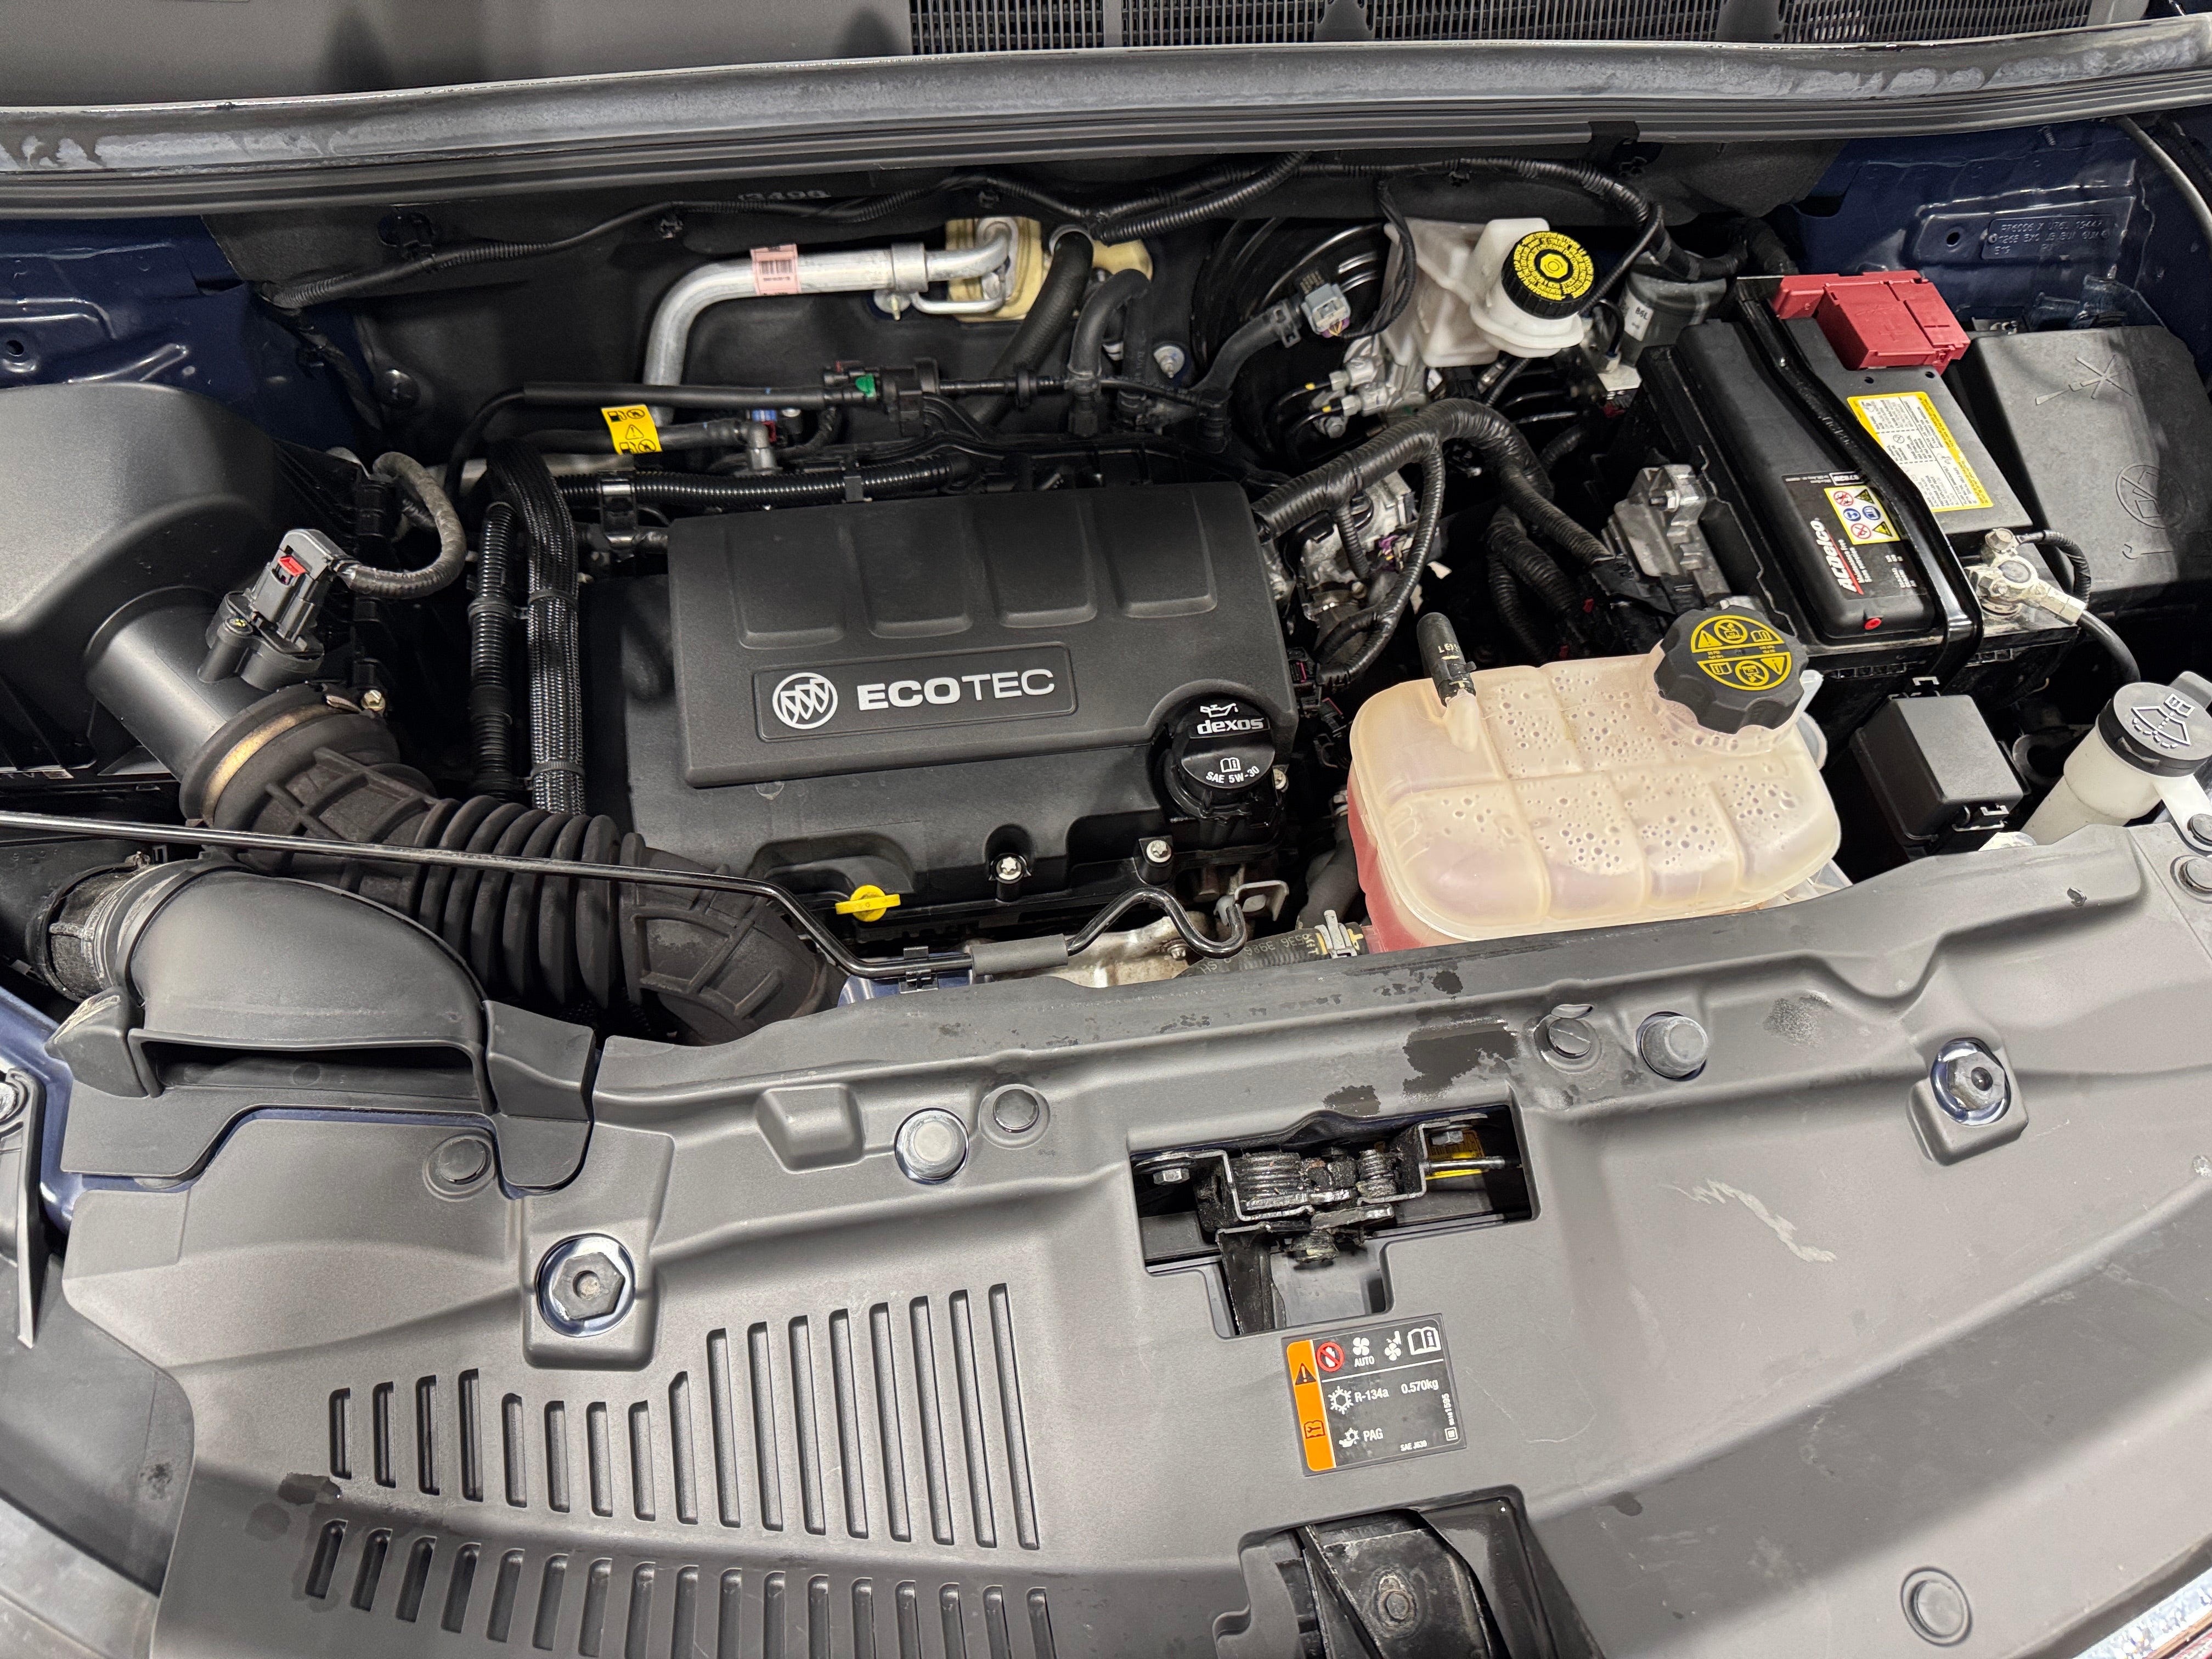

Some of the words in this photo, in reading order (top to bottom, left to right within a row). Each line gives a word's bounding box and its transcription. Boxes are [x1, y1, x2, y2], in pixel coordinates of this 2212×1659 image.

[1810, 521, 1857, 592] ACDelco
[857, 669, 1055, 711] ECOTEC
[1197, 718, 1264, 735] dexos
[1206, 771, 1225, 783] SAE
[1228, 765, 1260, 783] 5W-30
[1354, 1356, 1375, 1367] AUTO
[1354, 1387, 1390, 1403] R-134a
[1401, 1379, 1439, 1394] 0.570kg
[1363, 1428, 1384, 1442] PAG
[1400, 1443, 1412, 1452] SAE
